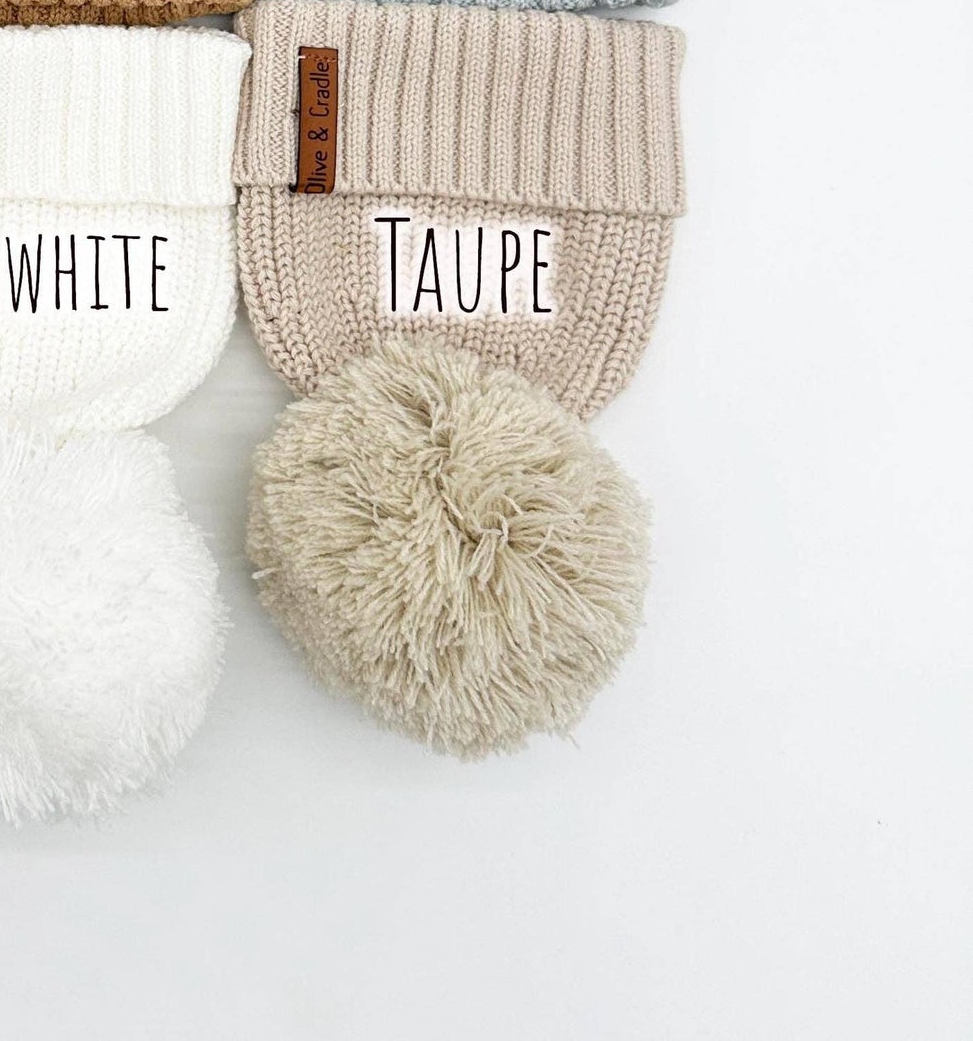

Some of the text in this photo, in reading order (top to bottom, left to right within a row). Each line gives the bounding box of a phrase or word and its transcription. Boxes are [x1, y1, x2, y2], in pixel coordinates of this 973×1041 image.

[304, 61, 330, 194] Olive & Cradle
